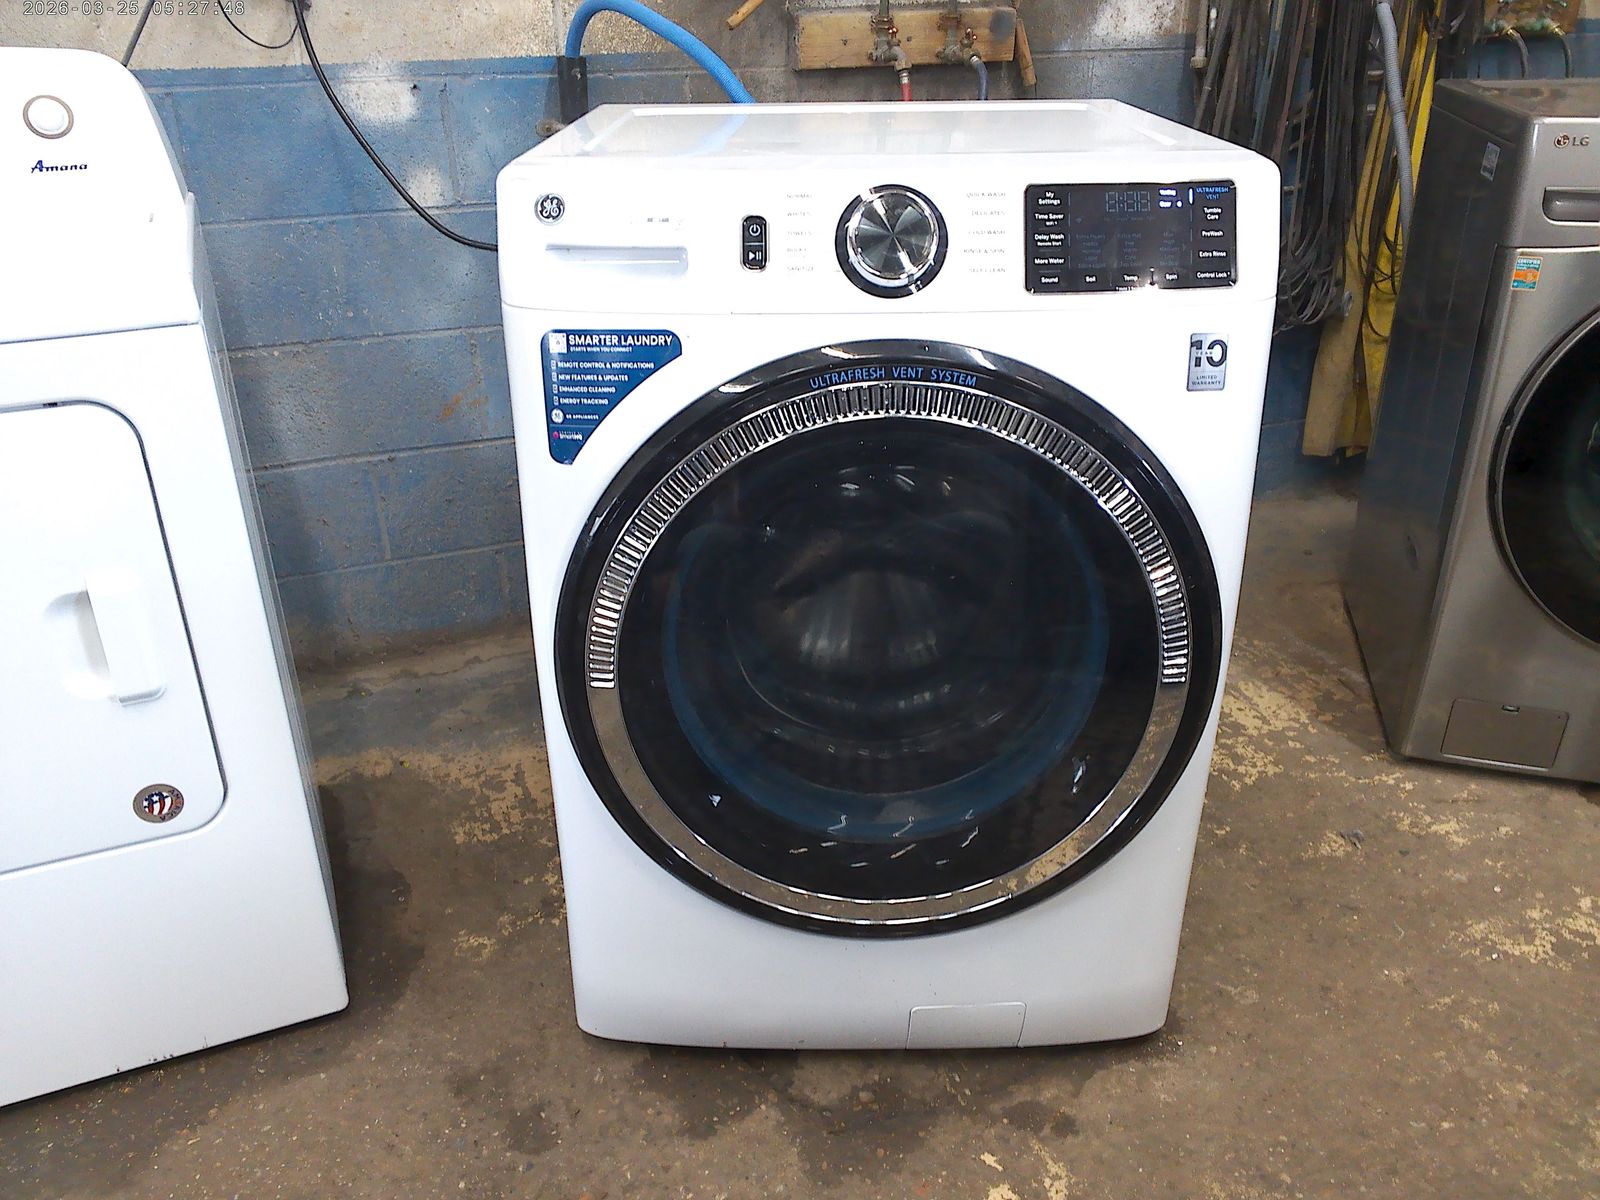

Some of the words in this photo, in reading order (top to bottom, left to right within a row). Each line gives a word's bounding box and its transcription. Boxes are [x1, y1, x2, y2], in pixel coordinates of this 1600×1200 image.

[1572, 136, 1590, 147] LG
[31, 160, 88, 174] Amana
[568, 334, 619, 346] SMARTER
[621, 334, 673, 347] LAUNDRY
[1190, 339, 1228, 368] 10
[558, 361, 579, 369] REMOTE
[580, 361, 605, 369] CONTROL
[612, 362, 655, 370] NOTIFICATIONS
[809, 367, 885, 389] ULTRAFRESH
[892, 366, 924, 379] VENT
[930, 368, 977, 387] SYSTEM
